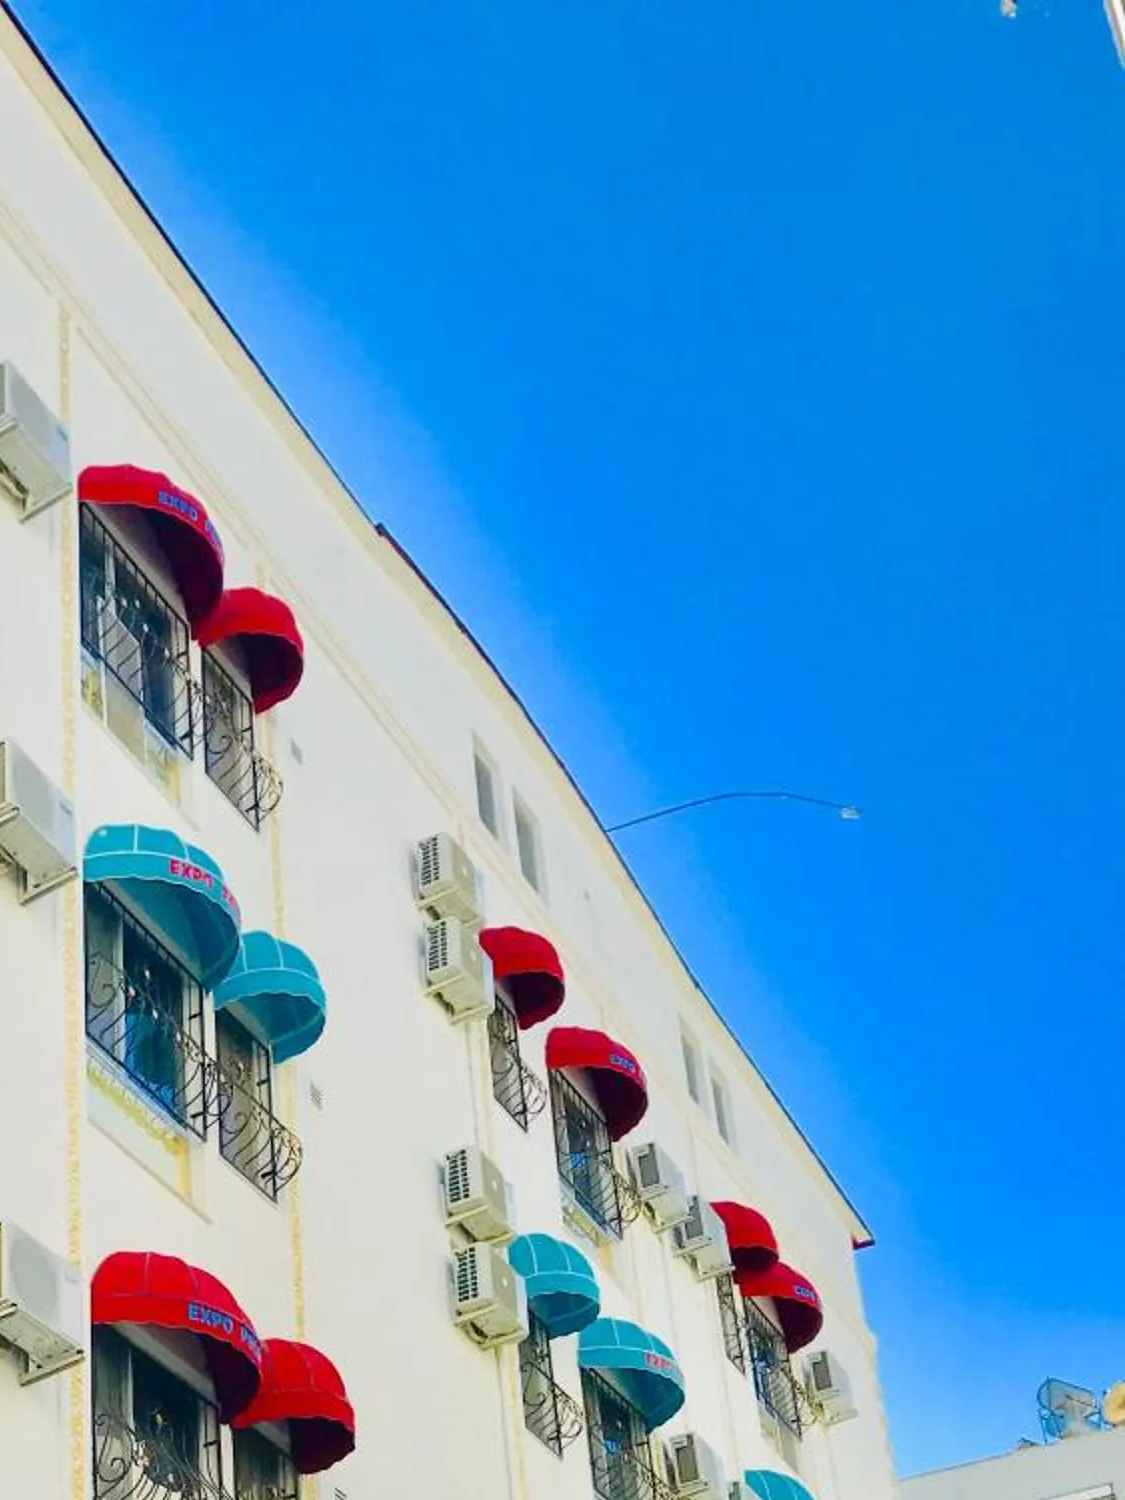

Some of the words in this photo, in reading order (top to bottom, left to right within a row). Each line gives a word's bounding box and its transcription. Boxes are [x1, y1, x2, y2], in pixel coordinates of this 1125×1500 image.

[158, 491, 198, 521] EXPO
[169, 857, 213, 889] EXPO
[188, 1301, 234, 1333] EXPO
